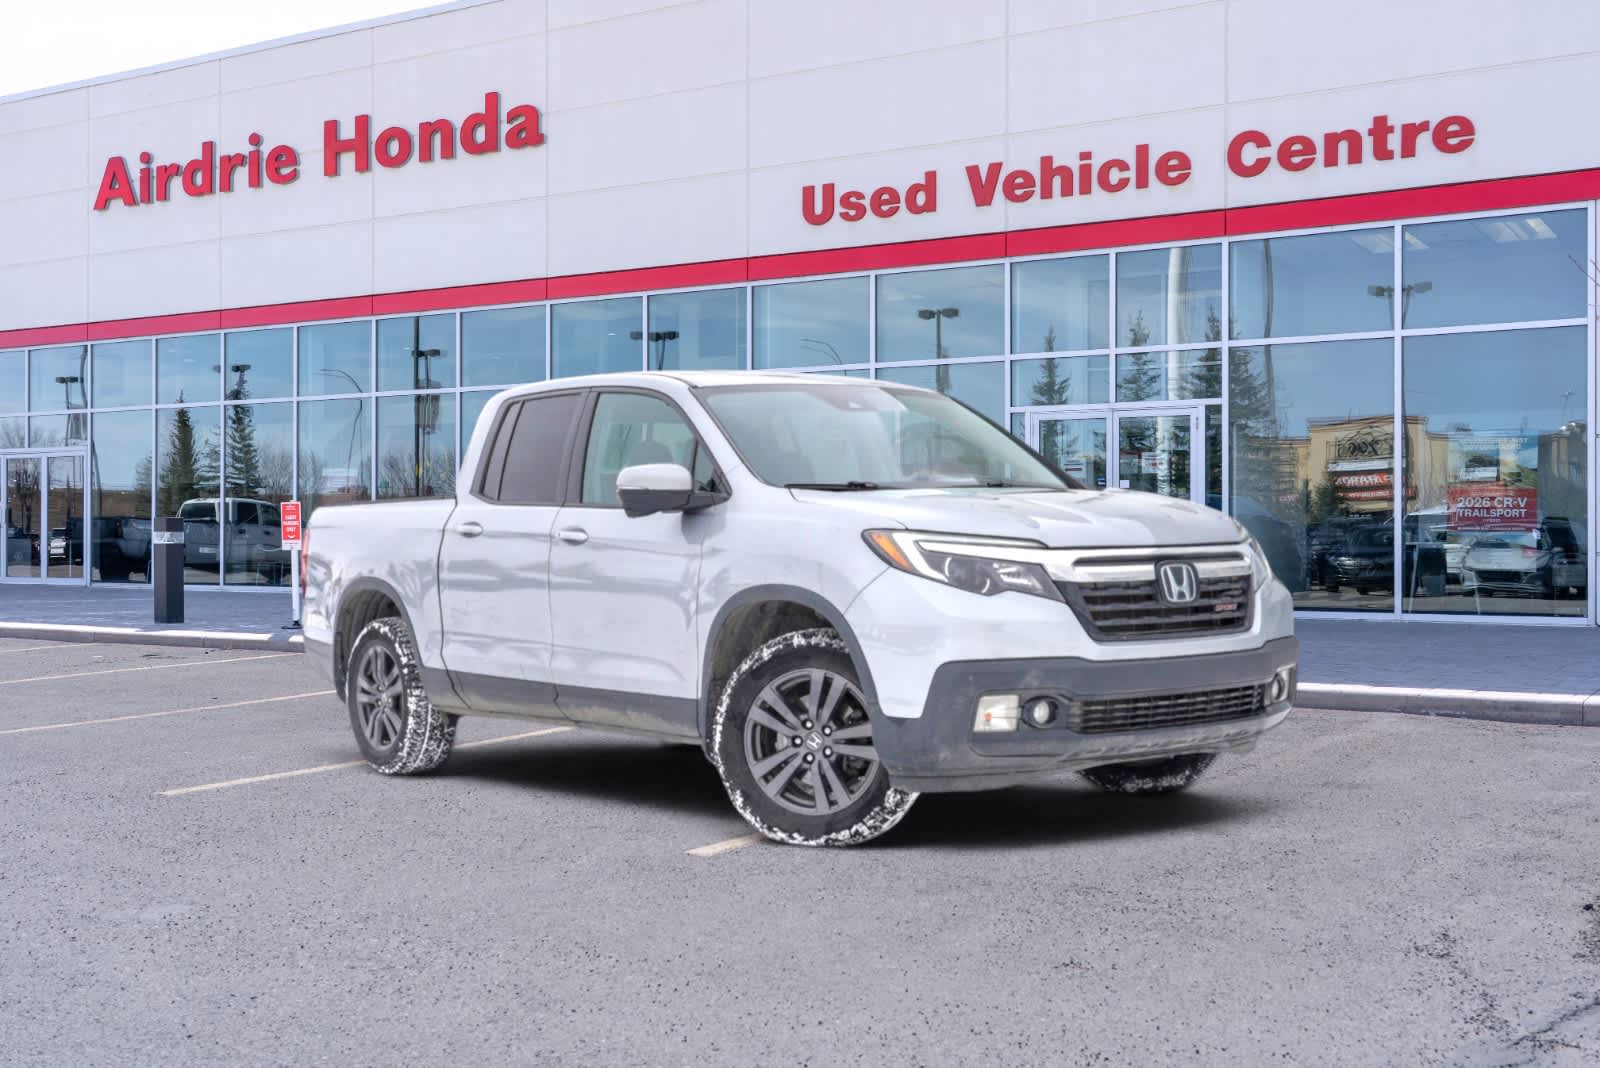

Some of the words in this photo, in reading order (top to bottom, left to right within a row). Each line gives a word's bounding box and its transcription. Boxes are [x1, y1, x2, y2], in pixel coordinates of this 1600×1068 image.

[94, 133, 299, 210] Airdrie
[323, 91, 546, 177] Honda
[802, 171, 938, 225] Used
[965, 144, 1192, 207] Vehicle
[1227, 115, 1476, 178] Centre
[1457, 497, 1490, 508] 2026
[1494, 496, 1528, 508] CR-V
[1458, 509, 1528, 517] TRAILSPORT
